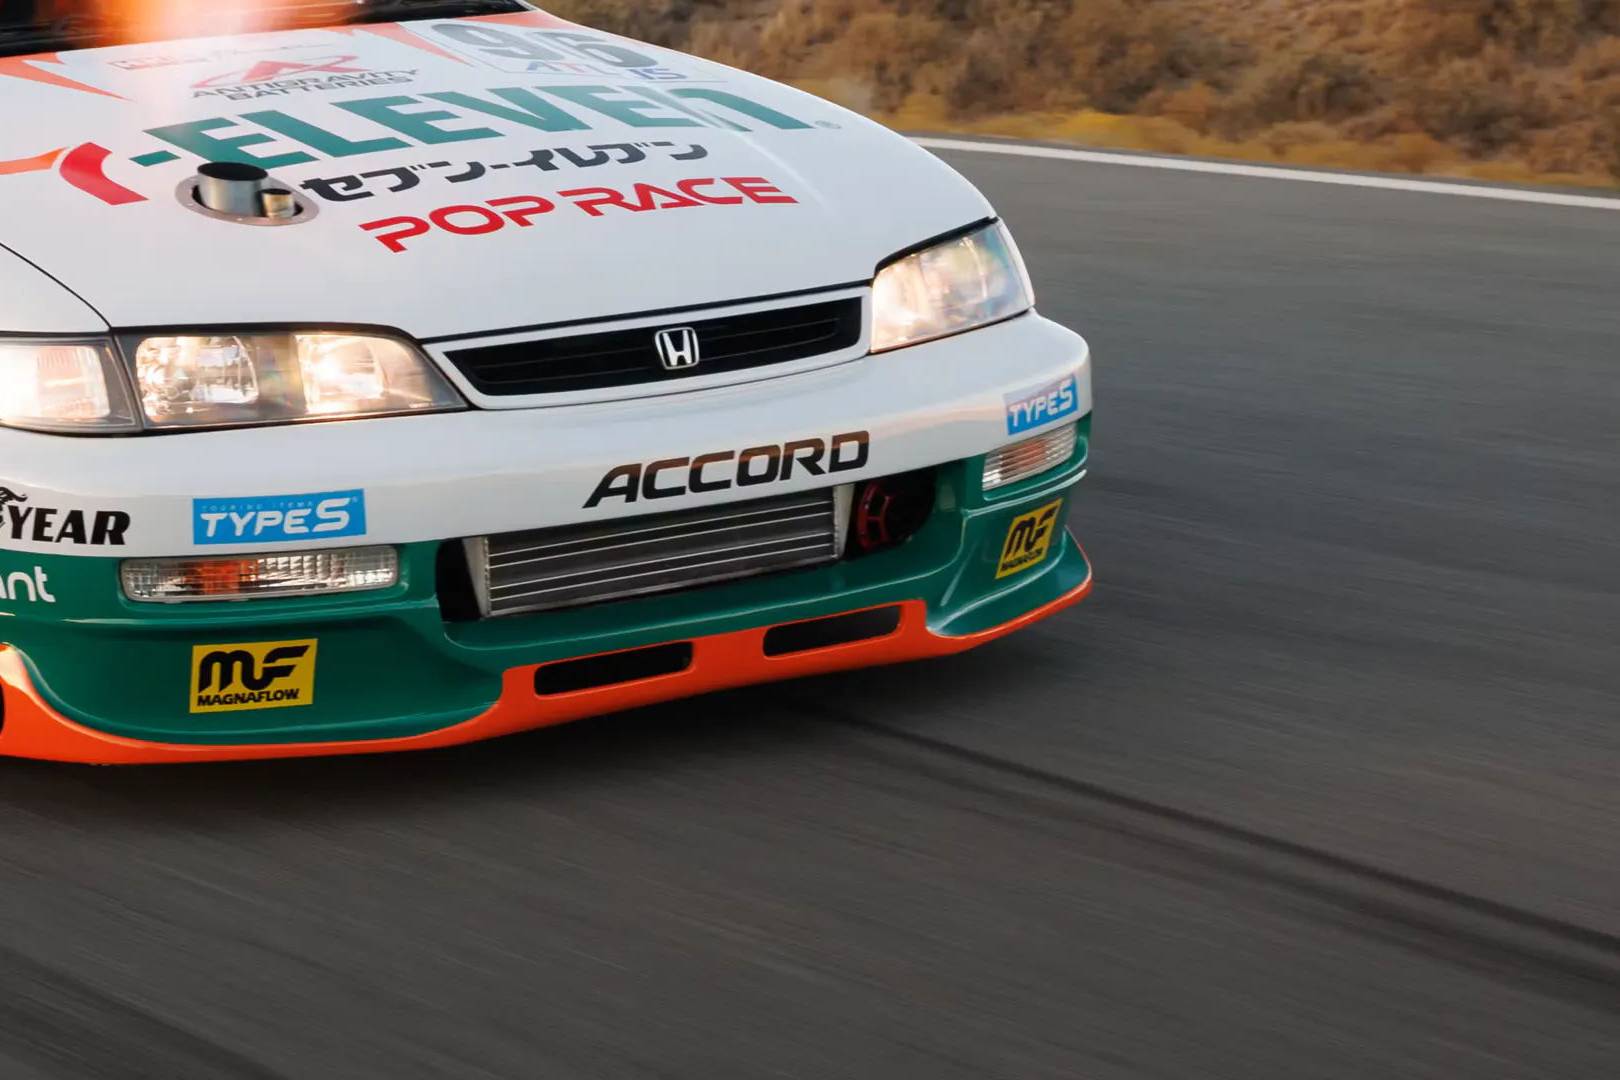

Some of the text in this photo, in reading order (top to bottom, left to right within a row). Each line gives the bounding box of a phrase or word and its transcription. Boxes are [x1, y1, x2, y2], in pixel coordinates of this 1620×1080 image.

[431, 23, 659, 68] 96
[192, 69, 420, 98] ANTIGRAVITY
[228, 76, 416, 101] BATTERIES
[358, 176, 800, 254] POP RACE
[583, 430, 870, 509] ACCORD
[196, 688, 300, 707] MAGNAFLOW
